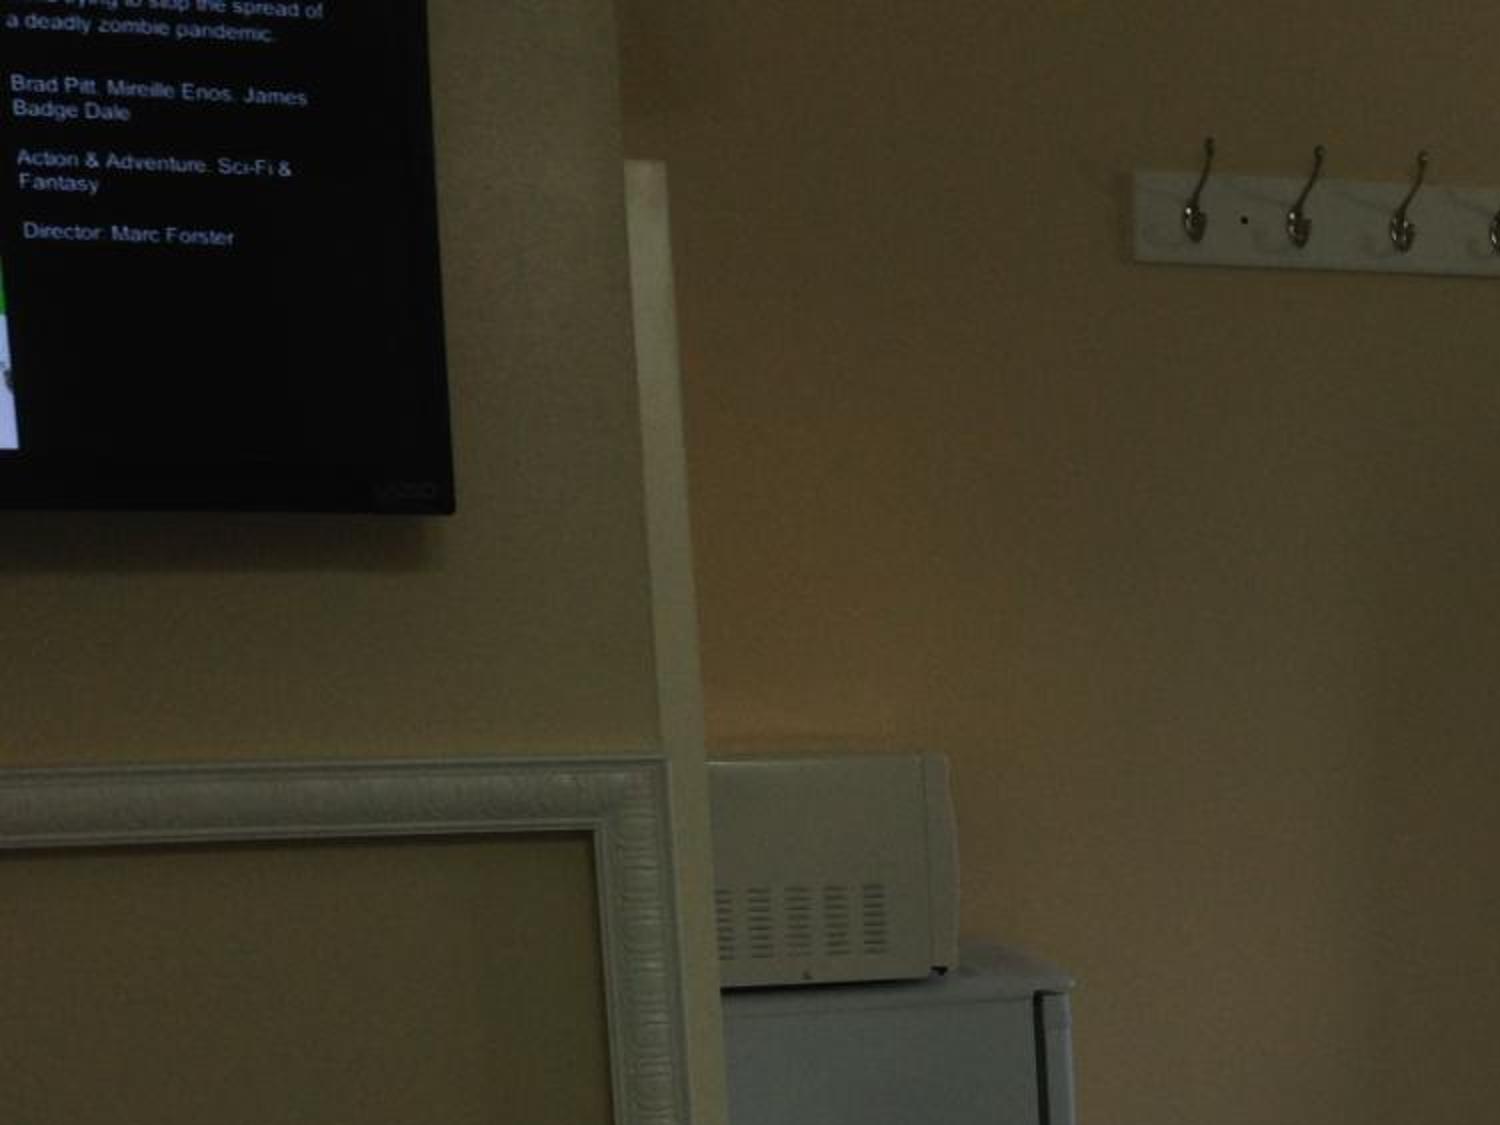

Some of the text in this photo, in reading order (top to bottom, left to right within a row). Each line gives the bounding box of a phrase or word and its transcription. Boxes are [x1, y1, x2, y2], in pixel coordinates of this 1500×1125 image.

[232, 0, 300, 19] spread
[305, 2, 324, 19] of
[5, 14, 20, 29] a
[23, 13, 92, 36] deadly
[97, 18, 171, 36] zombie
[10, 73, 59, 94] Brad
[106, 79, 177, 100] Mireille
[243, 87, 309, 107] James
[12, 98, 131, 122] Badge Dale
[16, 149, 80, 169] Action
[84, 151, 100, 169] &
[217, 157, 273, 176] Sci-Fi
[277, 159, 292, 177] &
[18, 172, 99, 197] Fantasy
[110, 226, 161, 243] Marc
[166, 228, 235, 247] Forster
